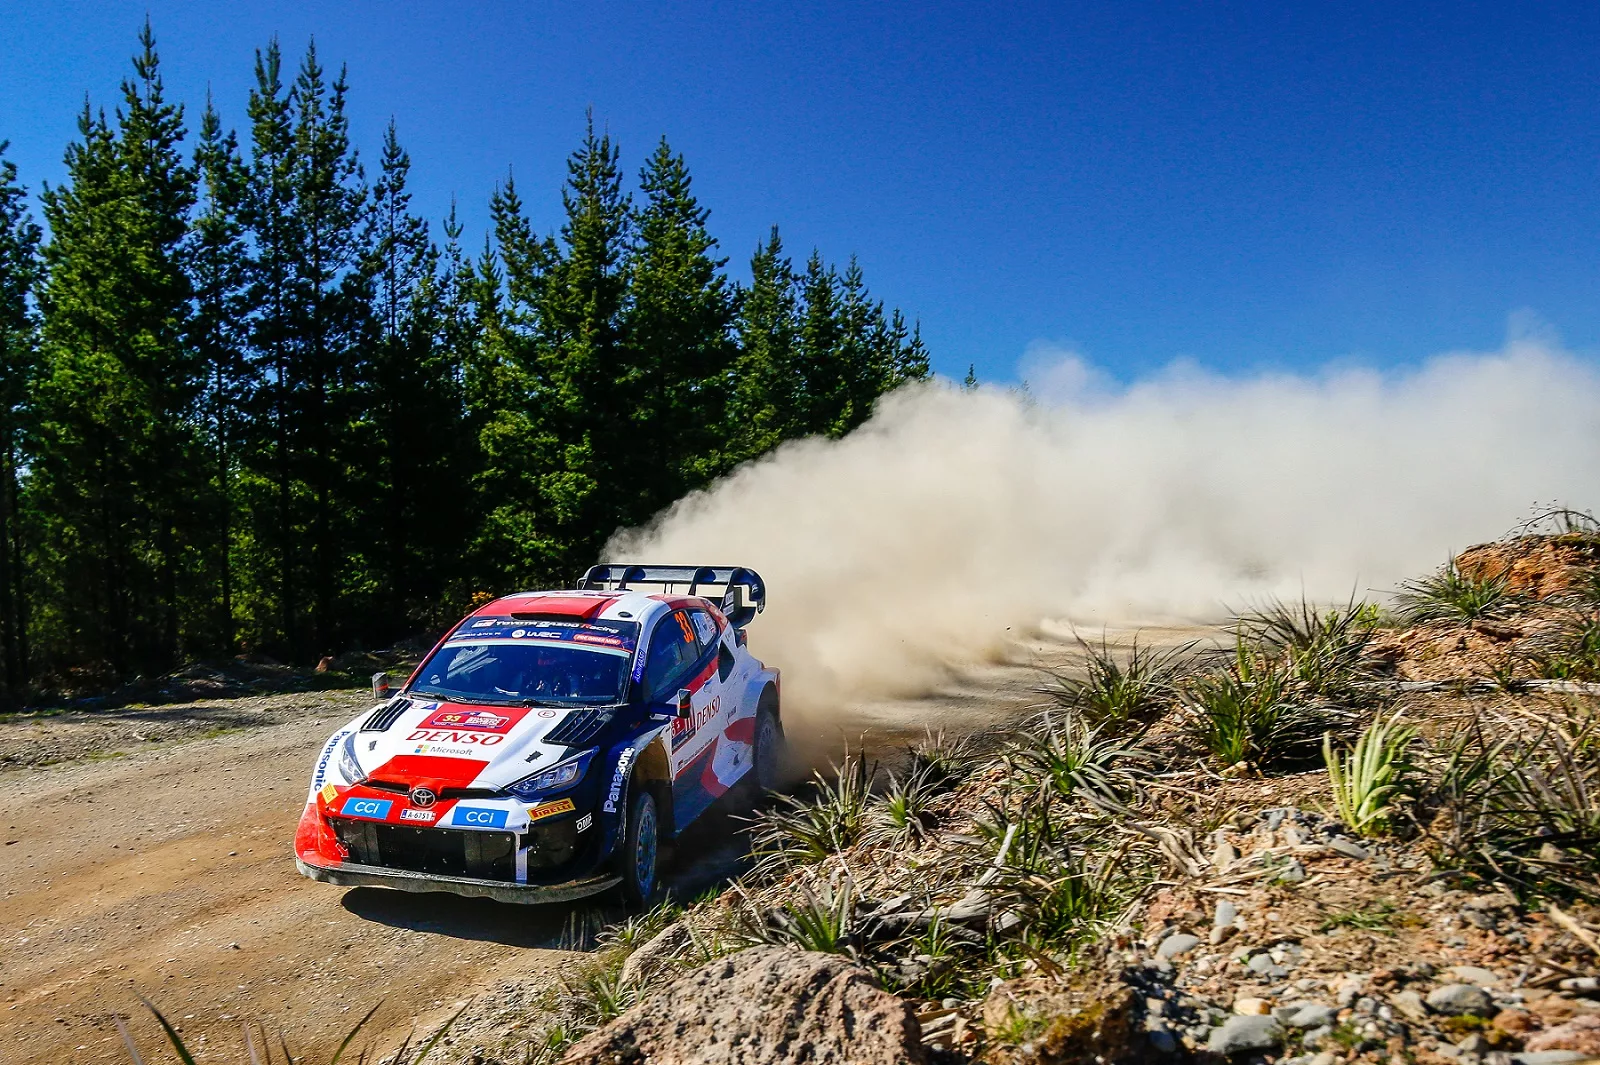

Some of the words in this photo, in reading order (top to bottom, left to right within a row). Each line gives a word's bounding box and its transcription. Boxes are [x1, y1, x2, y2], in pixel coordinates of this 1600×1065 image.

[580, 623, 619, 634] Racing
[675, 612, 695, 644] 33
[697, 695, 720, 732] DENSO
[406, 730, 504, 746] DENSO
[430, 746, 472, 756] Microsoft
[314, 731, 350, 792] Panasonic
[603, 748, 635, 813] Panasonic
[531, 800, 571, 818] PIRELLI
[576, 815, 592, 830] OMP
